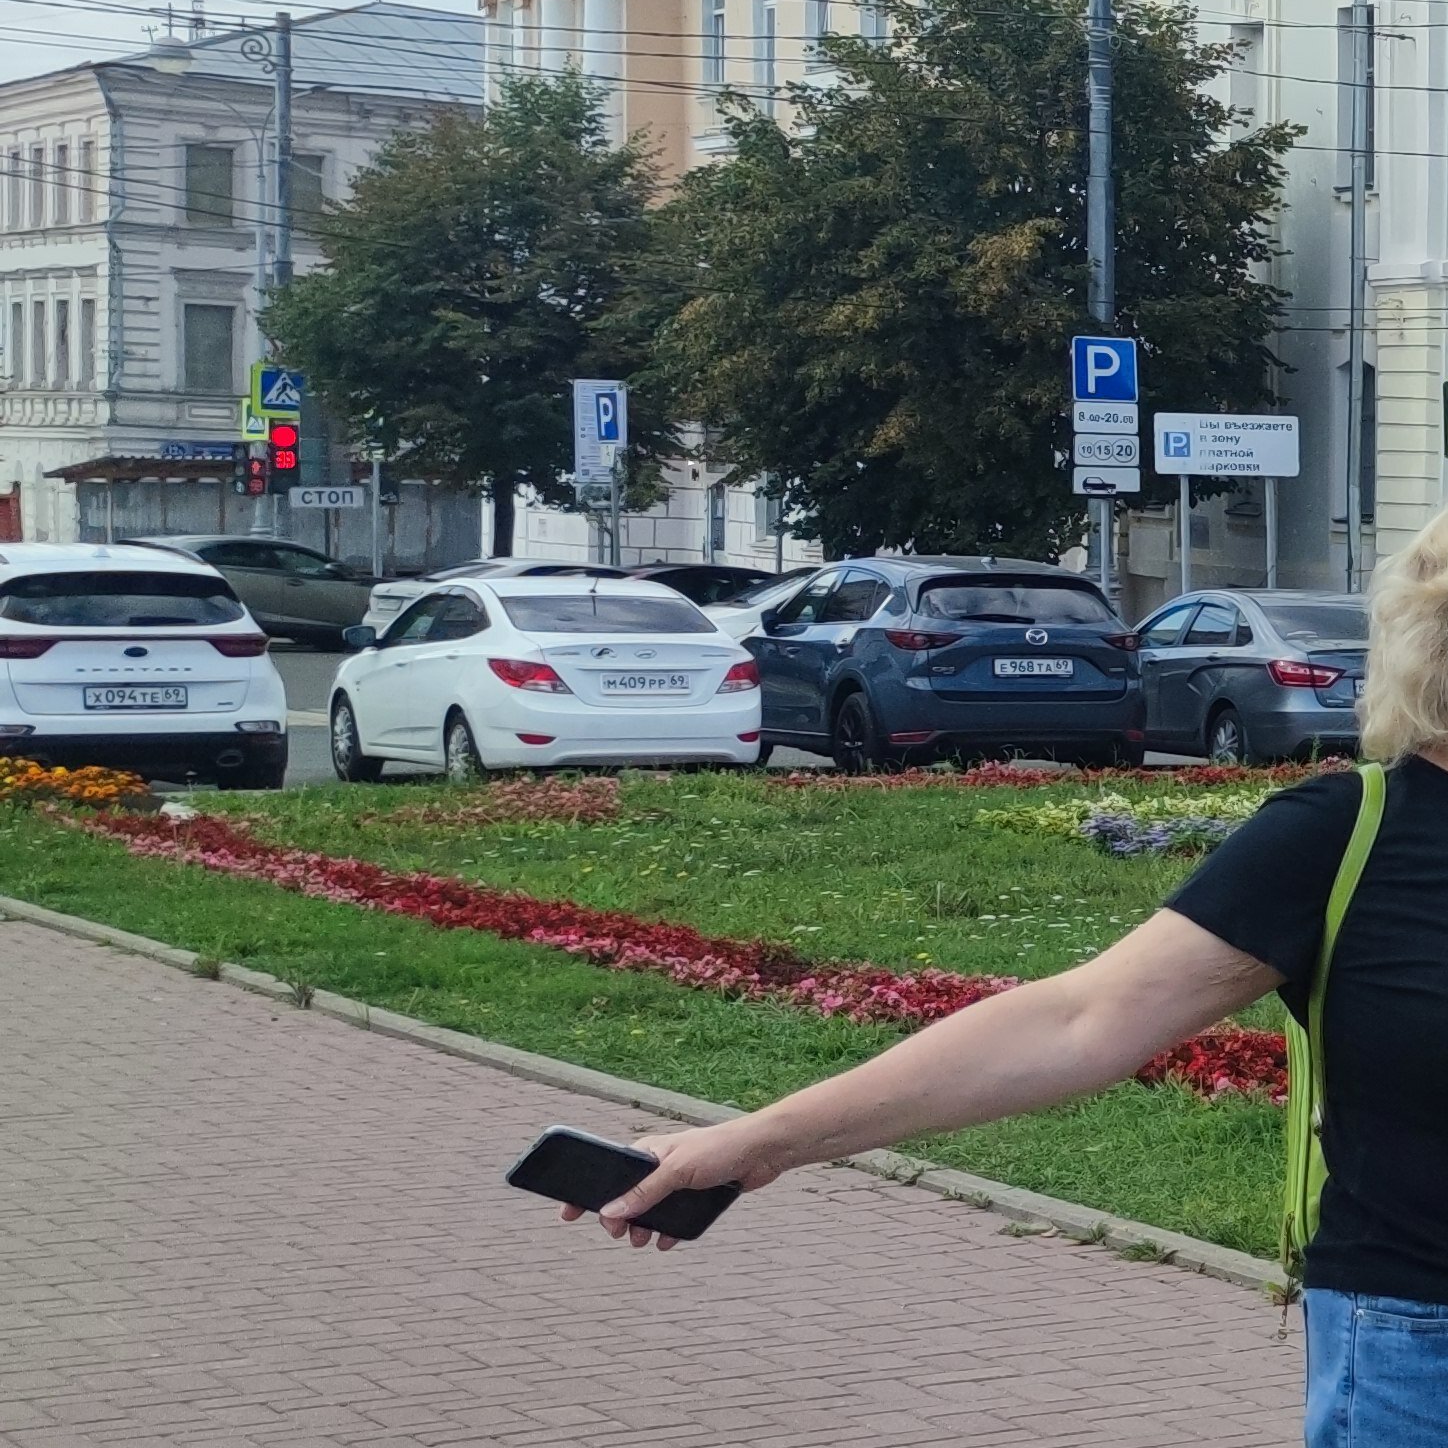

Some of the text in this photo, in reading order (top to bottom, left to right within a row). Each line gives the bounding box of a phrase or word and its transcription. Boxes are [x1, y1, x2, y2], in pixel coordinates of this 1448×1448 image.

[1211, 435, 1241, 446] зону
[1081, 444, 1133, 457] 10 15 20
[301, 490, 354, 504] СТОП
